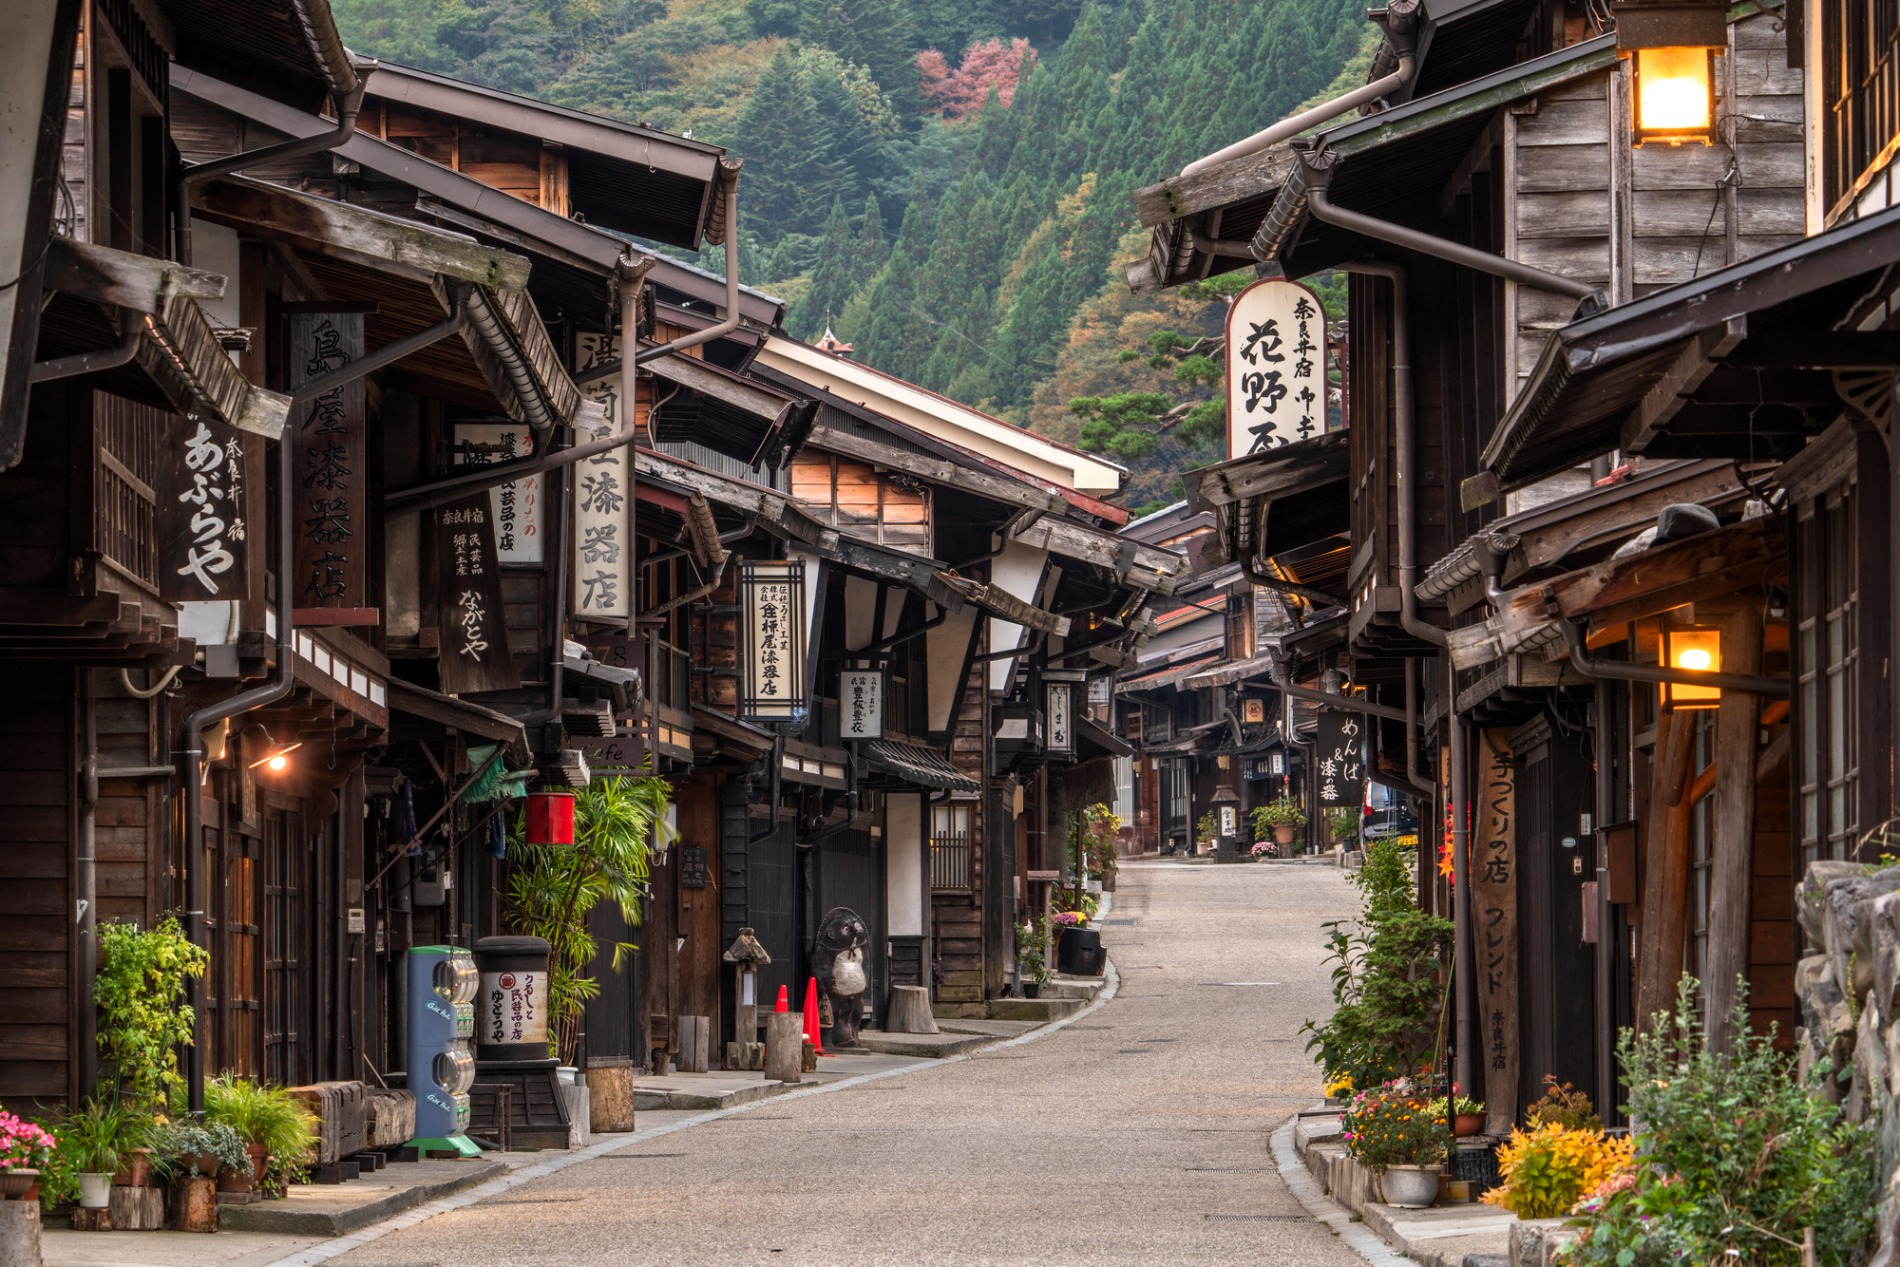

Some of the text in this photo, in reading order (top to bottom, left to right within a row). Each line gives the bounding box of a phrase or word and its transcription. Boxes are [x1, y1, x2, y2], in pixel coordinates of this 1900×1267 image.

[1292, 297, 1317, 379] 奈良井宿
[225, 437, 245, 541] 奈良井宿
[301, 319, 353, 600] 島屋漆器店
[177, 422, 234, 595] あぶらや
[442, 507, 484, 525] 奈良井宿
[453, 533, 468, 576] 郷土土産
[469, 533, 484, 575] 民芸品
[459, 589, 489, 662] ながとや
[1319, 756, 1339, 800] 漆の器
[1334, 747, 1344, 761] &
[1341, 717, 1360, 781] めんば
[1481, 752, 1514, 1071] 手づくりの店 フレンド 奈良井宿
[524, 974, 534, 1020] うるしと
